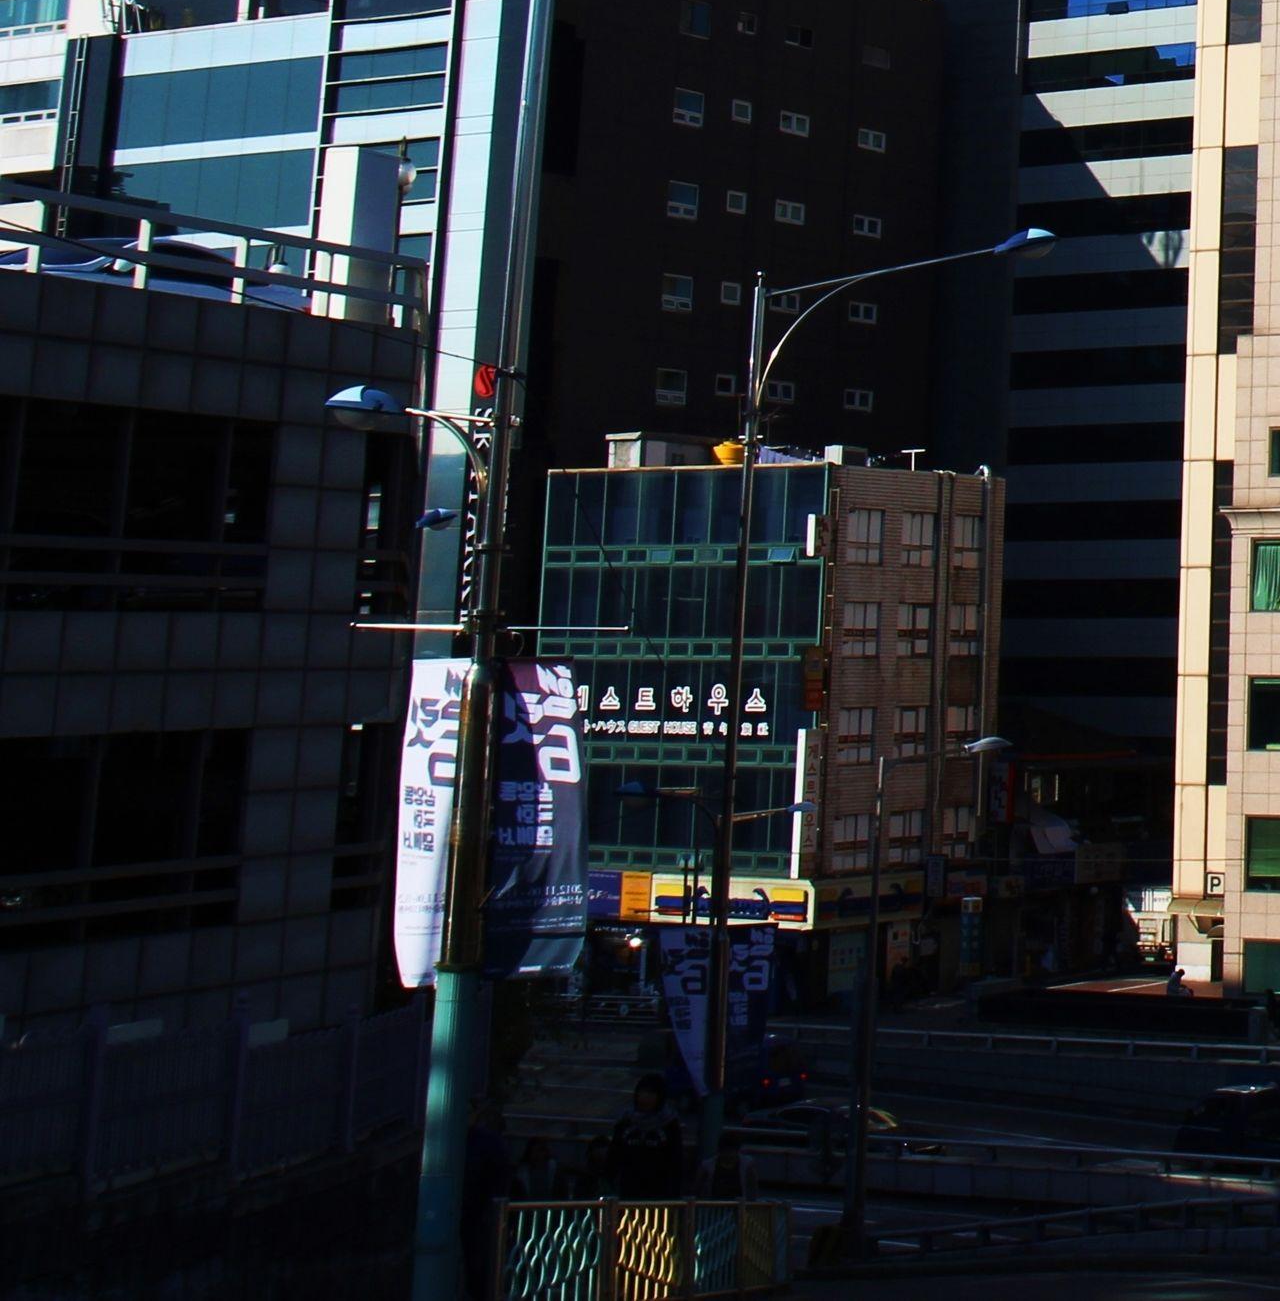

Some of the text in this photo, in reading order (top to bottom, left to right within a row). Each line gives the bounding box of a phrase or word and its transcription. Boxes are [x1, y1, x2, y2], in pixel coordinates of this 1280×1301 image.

[627, 720, 660, 735] GUEST
[664, 720, 697, 735] HOUSE
[804, 744, 820, 848] 게스트우스
[1210, 876, 1222, 892] P
